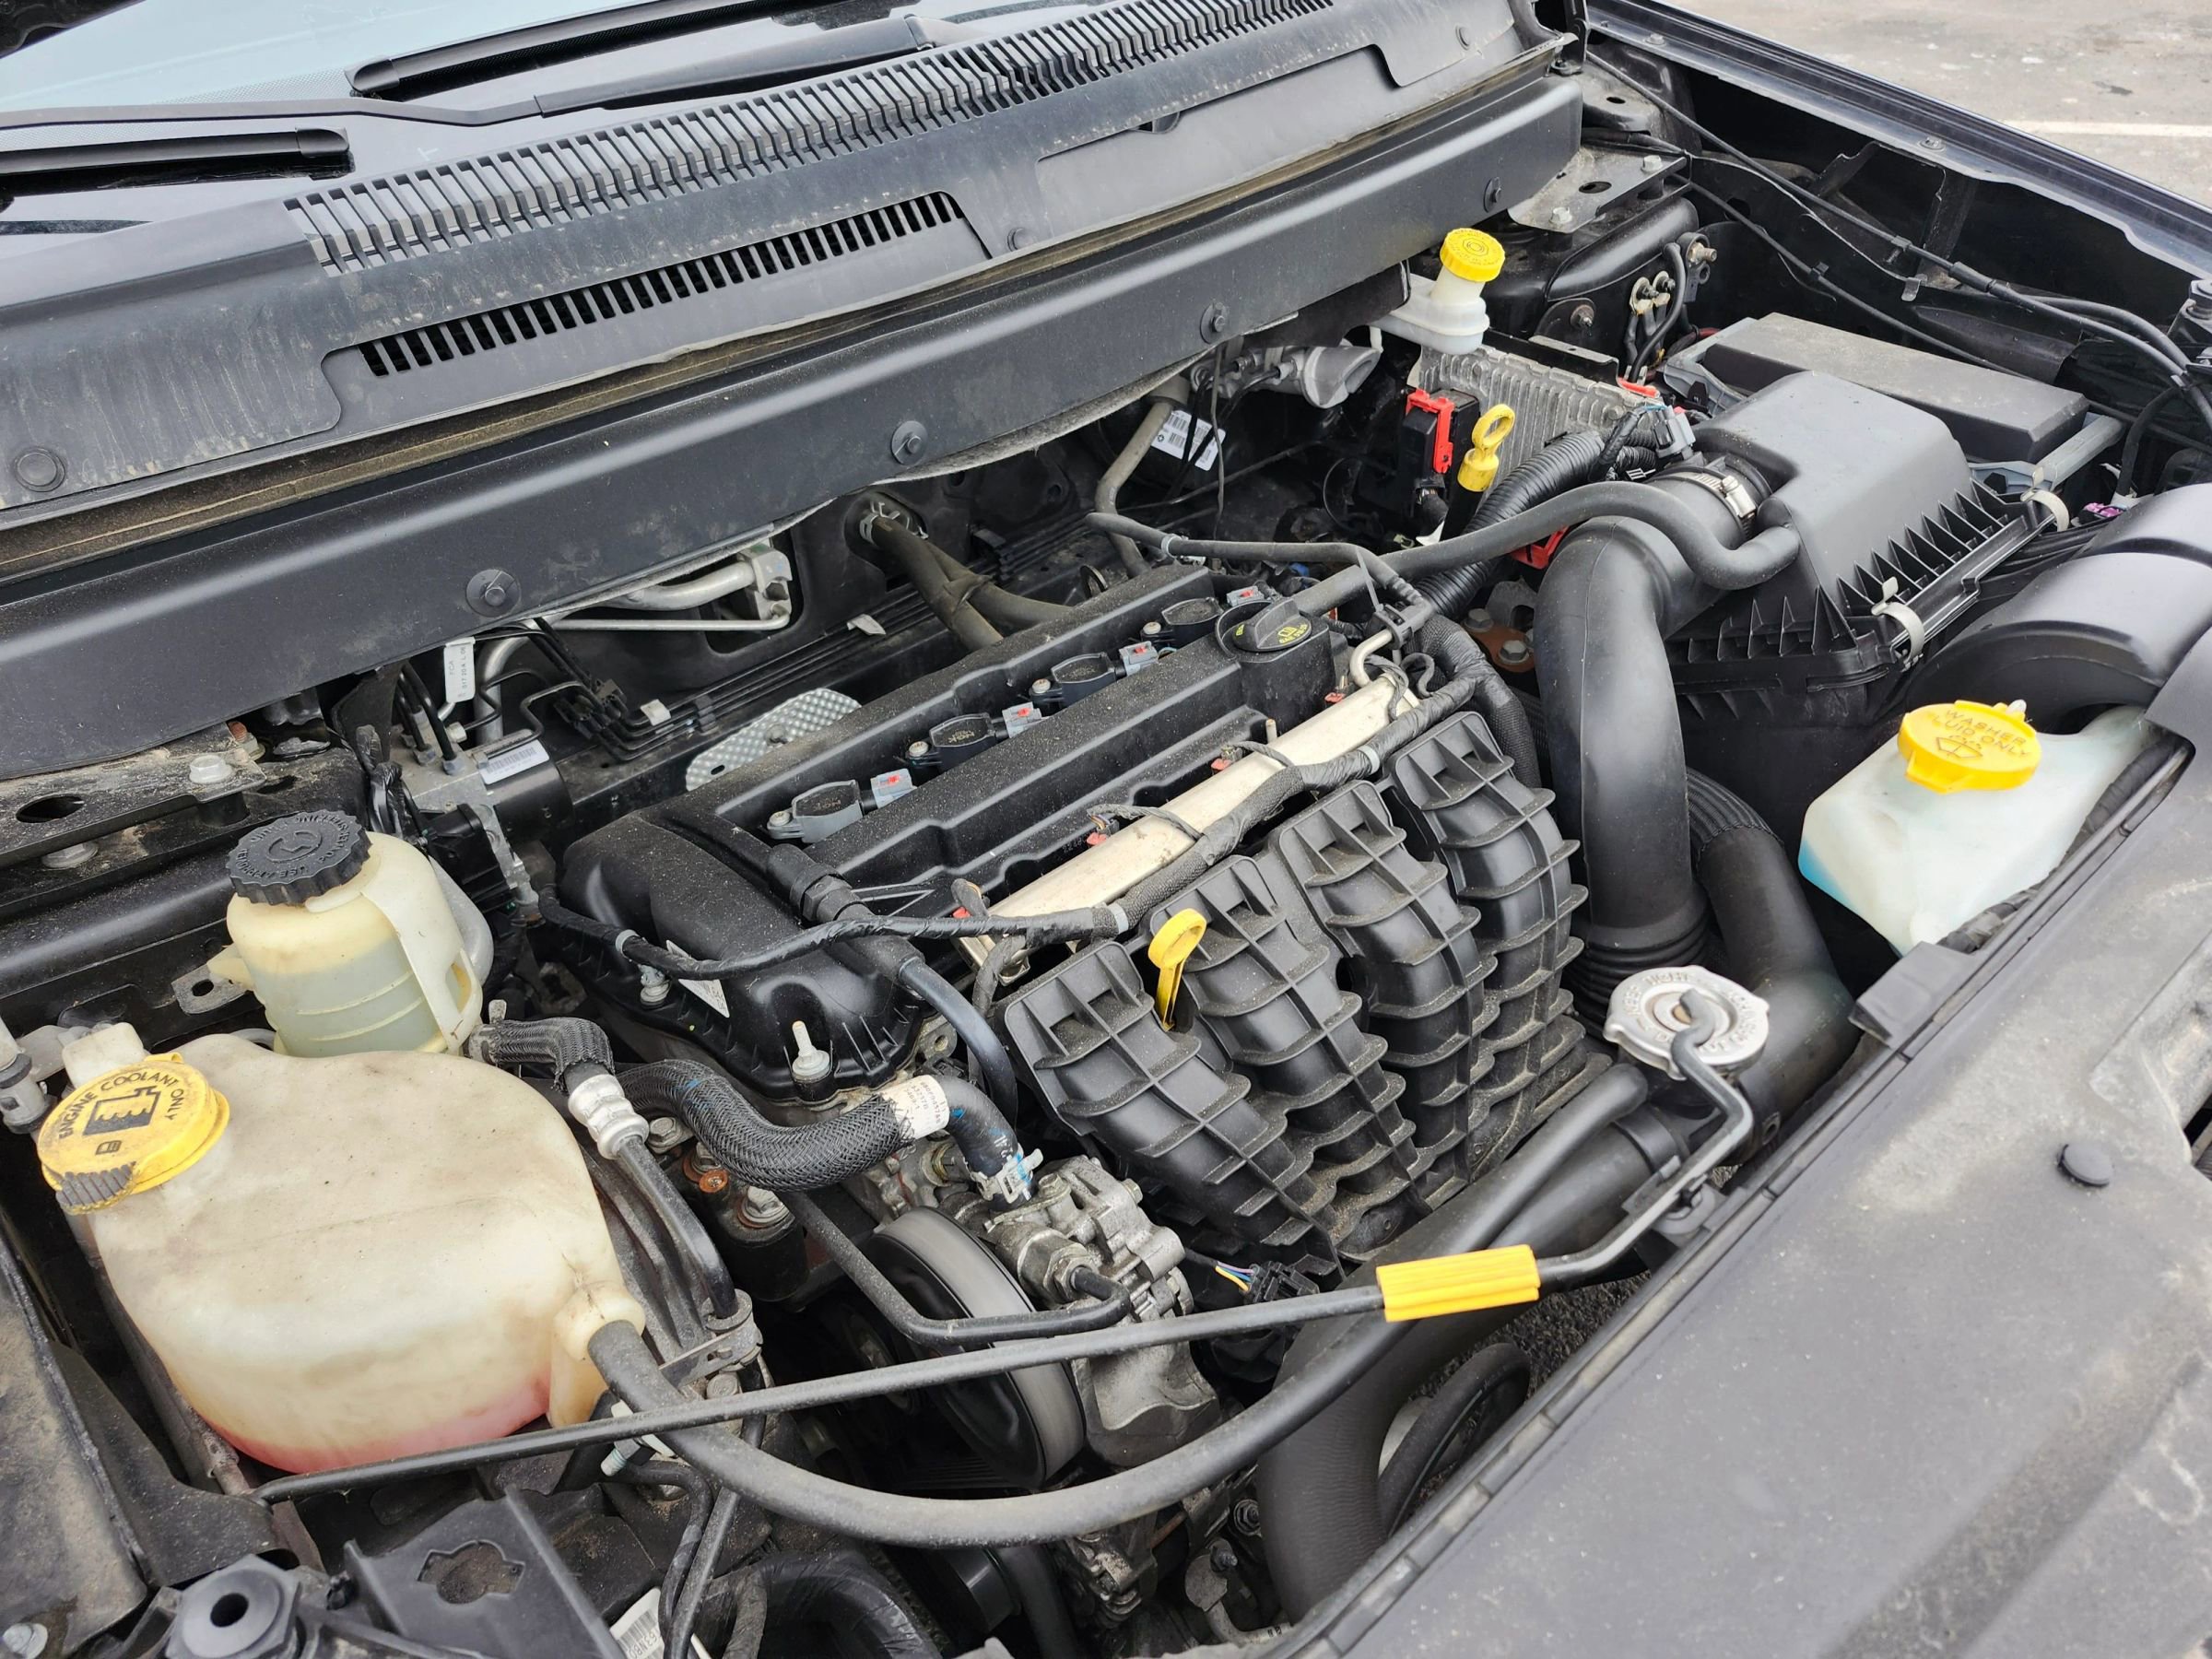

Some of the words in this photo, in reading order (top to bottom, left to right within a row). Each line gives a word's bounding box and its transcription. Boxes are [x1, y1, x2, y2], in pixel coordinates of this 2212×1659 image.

[1931, 712, 1976, 735] LUID
[1981, 735, 2030, 757] ONLY
[1946, 710, 2027, 745] WASHER
[59, 1092, 96, 1140] ENGINE
[100, 1072, 179, 1091] COOLANT
[164, 1088, 185, 1121] ONLY
